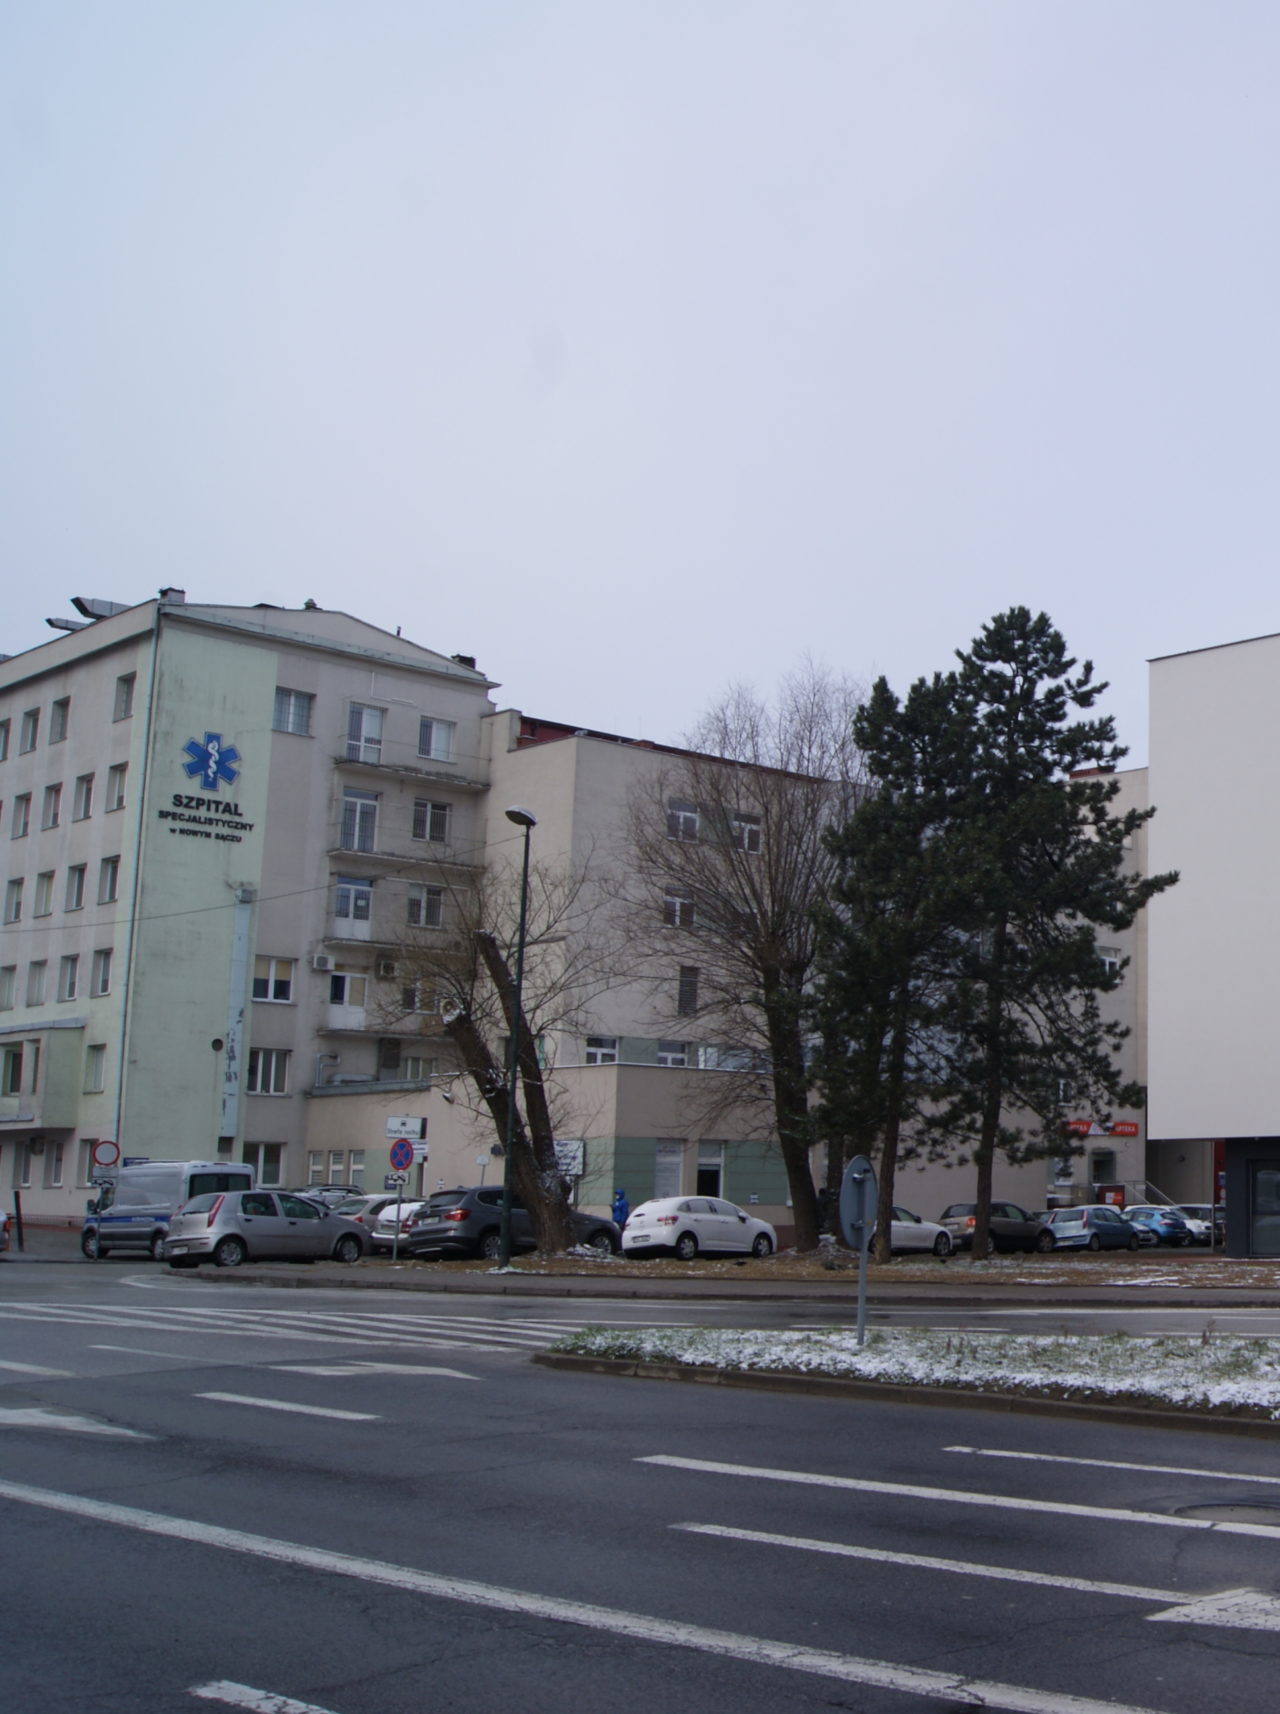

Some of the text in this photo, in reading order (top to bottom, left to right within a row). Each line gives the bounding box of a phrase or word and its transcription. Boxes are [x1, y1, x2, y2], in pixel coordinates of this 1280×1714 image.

[172, 793, 244, 817] SZPITAL
[158, 810, 255, 832] SPECJALISTYCZNY
[179, 827, 212, 839] NOWYM
[214, 832, 243, 843] SĄCZU
